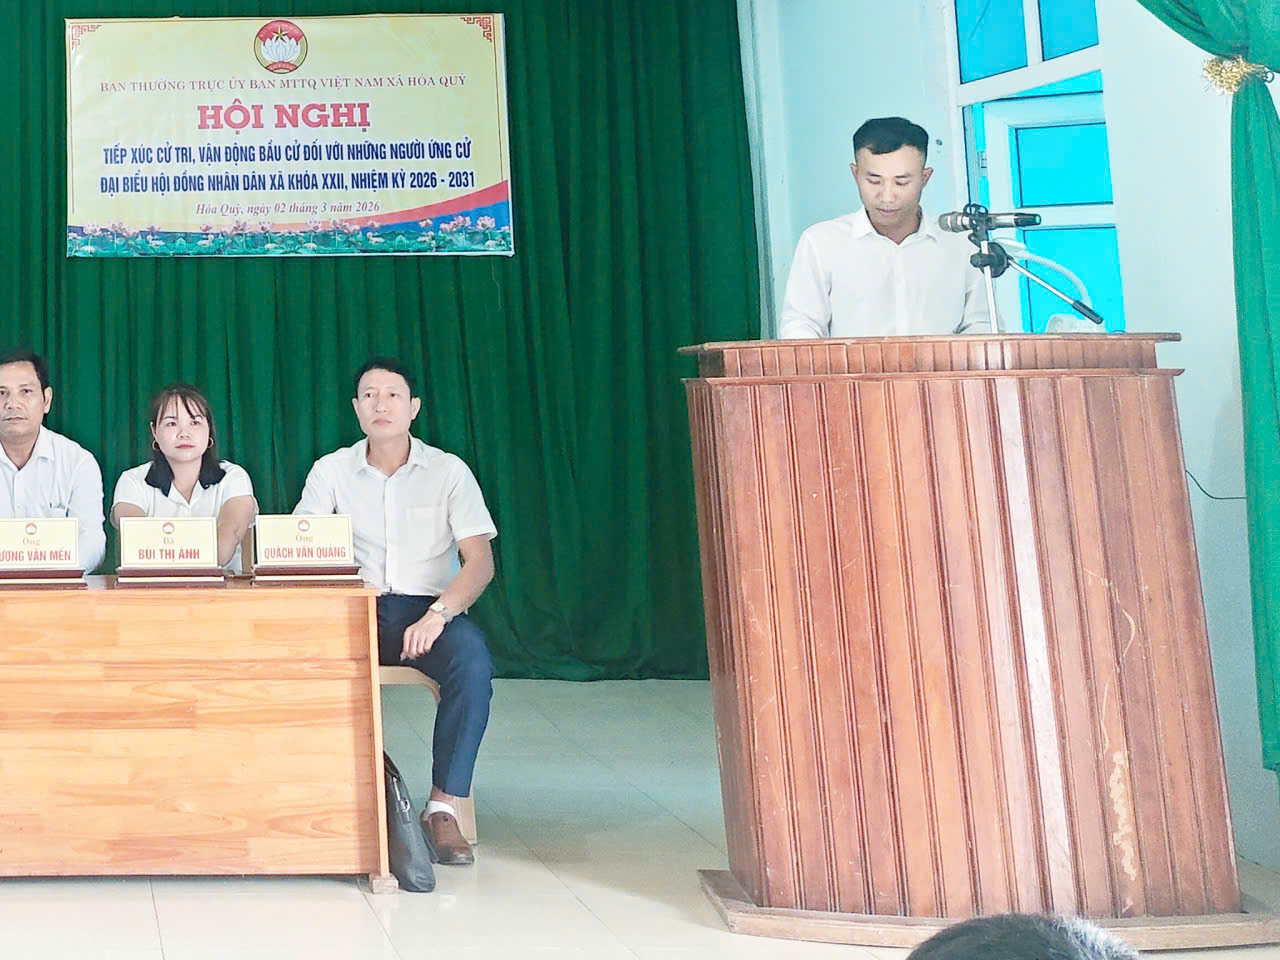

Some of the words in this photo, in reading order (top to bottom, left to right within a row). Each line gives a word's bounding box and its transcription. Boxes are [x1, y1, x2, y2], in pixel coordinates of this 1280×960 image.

[100, 82, 127, 92] BAN
[189, 80, 225, 92] TRỰC
[250, 79, 276, 89] BAN
[280, 79, 317, 89] MTTQ
[320, 75, 351, 90] VIỆT
[354, 77, 384, 87] NAM
[197, 98, 264, 134] HỘI
[273, 102, 370, 132] NGHỊ
[103, 142, 127, 164] TIẾP
[131, 144, 153, 164] XÚC
[157, 141, 173, 164] CỬ
[175, 147, 196, 165] TRI,
[198, 143, 221, 166] VẬN
[224, 142, 256, 166] ĐỘNG
[285, 139, 301, 161] CỬ
[303, 138, 323, 161] ĐỐI
[325, 141, 344, 161] VỚI
[347, 140, 386, 160] NHỮNG
[390, 139, 425, 159] NGƯỜI
[428, 139, 452, 159] ỨNG
[455, 136, 472, 159] CỬ
[100, 175, 119, 197] ĐẠI
[122, 170, 148, 192] BIỂU
[151, 173, 170, 196] HỘI
[207, 171, 239, 191] NHÂN
[242, 171, 266, 190] DÂN
[269, 171, 284, 190] XÃ
[288, 170, 319, 190] KHÓA
[322, 172, 348, 191] XXII,
[351, 169, 389, 192] NHIỆM
[392, 168, 406, 189] KỲ
[409, 172, 438, 188] 2026
[448, 171, 475, 188] 2031
[247, 204, 271, 217] ngày
[274, 203, 286, 214] 02
[289, 202, 318, 215] tháng
[320, 202, 327, 213] 3
[329, 202, 352, 213] năm
[355, 201, 380, 212] 2026
